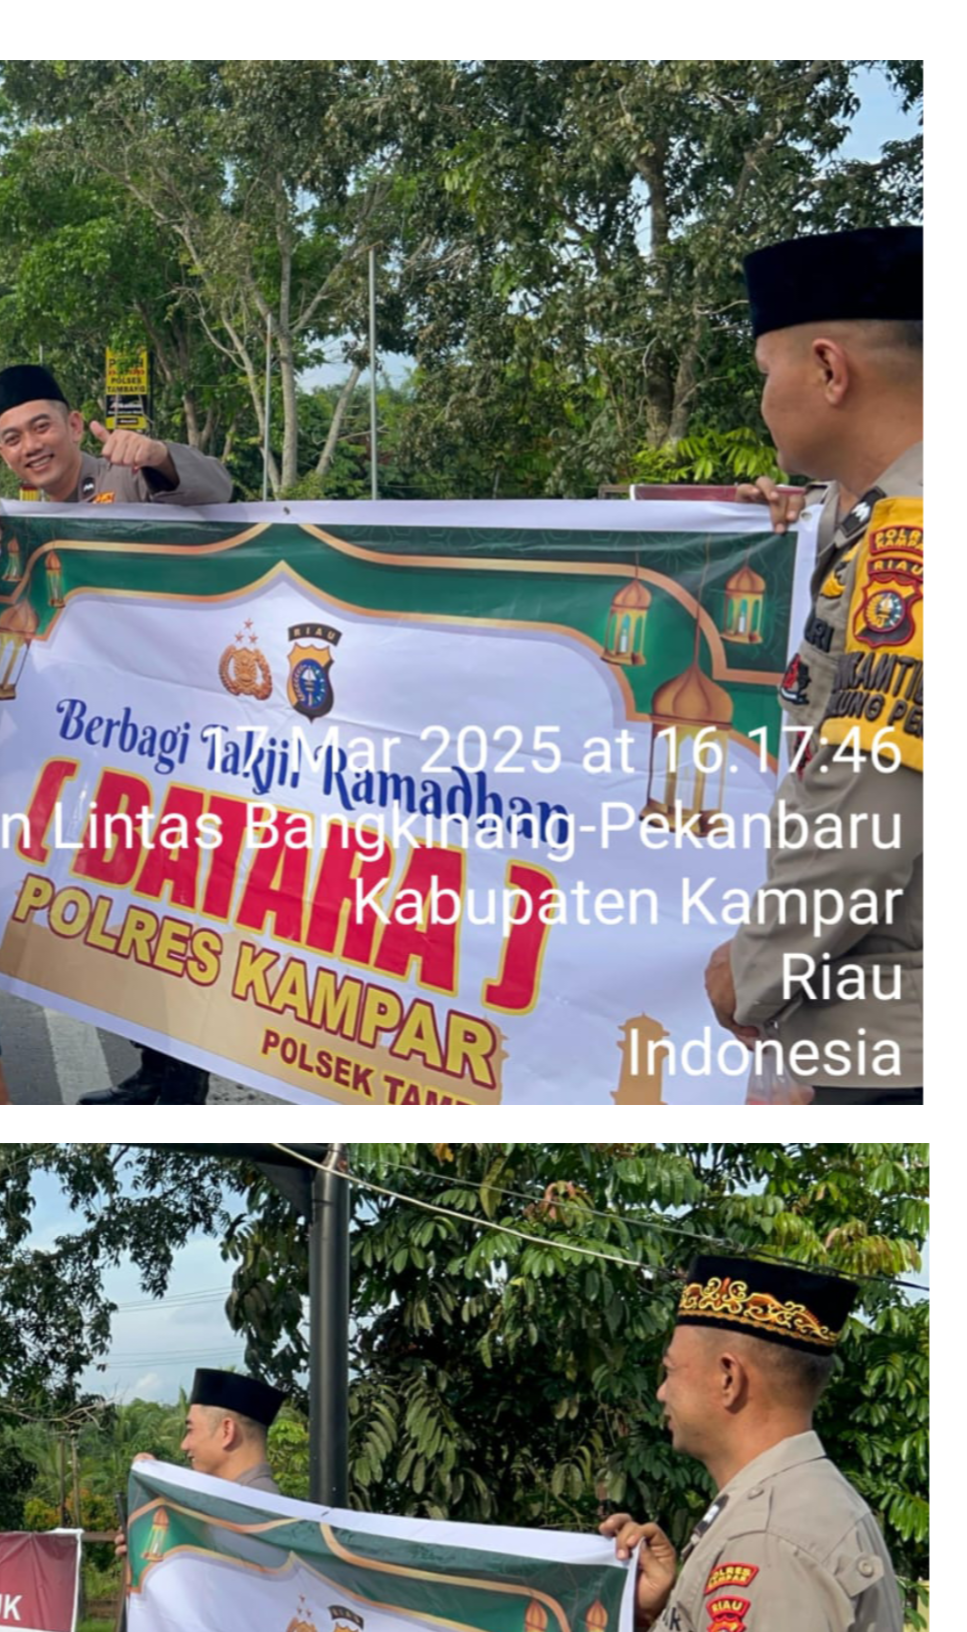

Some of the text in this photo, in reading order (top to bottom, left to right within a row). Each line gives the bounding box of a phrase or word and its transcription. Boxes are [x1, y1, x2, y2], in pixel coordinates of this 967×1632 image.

[56, 698, 570, 850] Berbagi Takjil Ramadhan
[68, 767, 466, 997] BATARA
[10, 872, 497, 1090] POLRES KAMPAR
[261, 1028, 375, 1098] POLSEK
